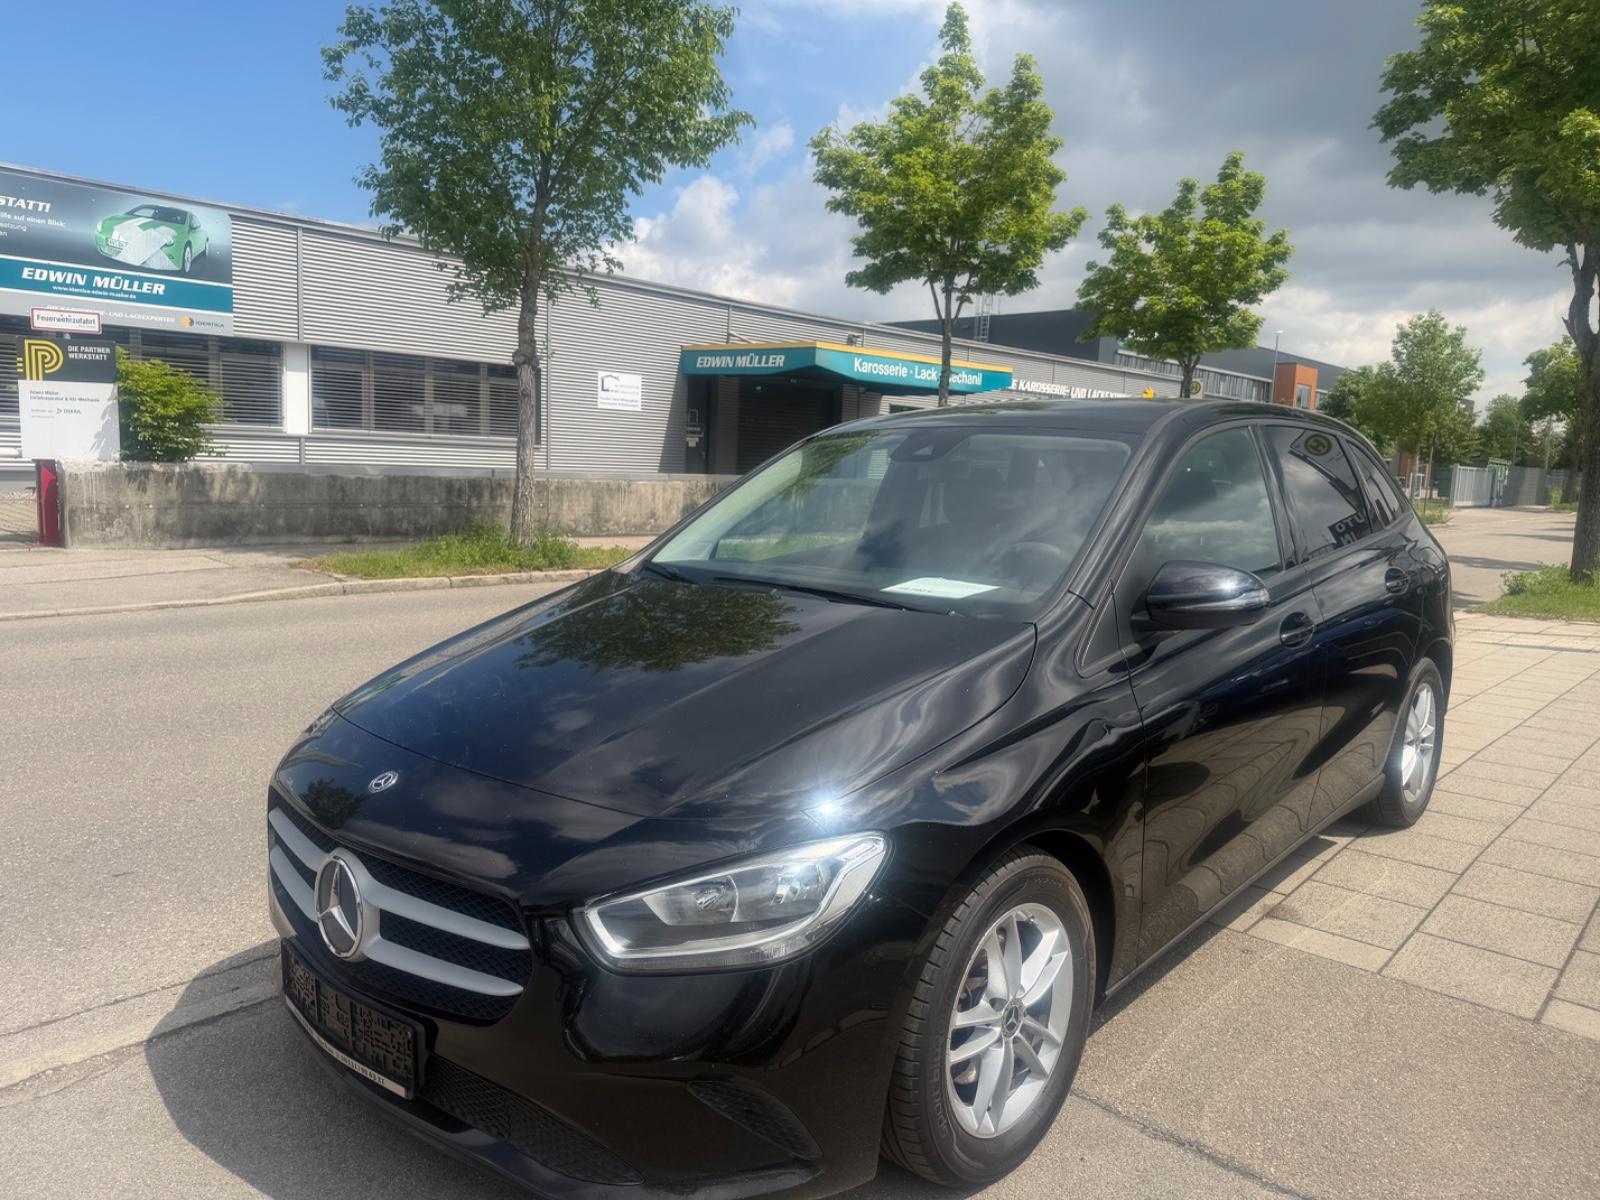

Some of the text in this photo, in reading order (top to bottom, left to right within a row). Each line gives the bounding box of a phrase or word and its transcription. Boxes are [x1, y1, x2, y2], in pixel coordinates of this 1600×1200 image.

[22, 267, 166, 295] EDWIN MÜLLER
[36, 313, 97, 326] Feuerwehrzufahrt
[67, 345, 111, 354] DIE PARTNER
[67, 353, 108, 361] WERKSTATT
[696, 353, 785, 368] EDWIN MÜLLER
[853, 356, 908, 379] Karosserie
[914, 365, 938, 381] Lack
[1018, 379, 1070, 396] KAROSSERIE-
